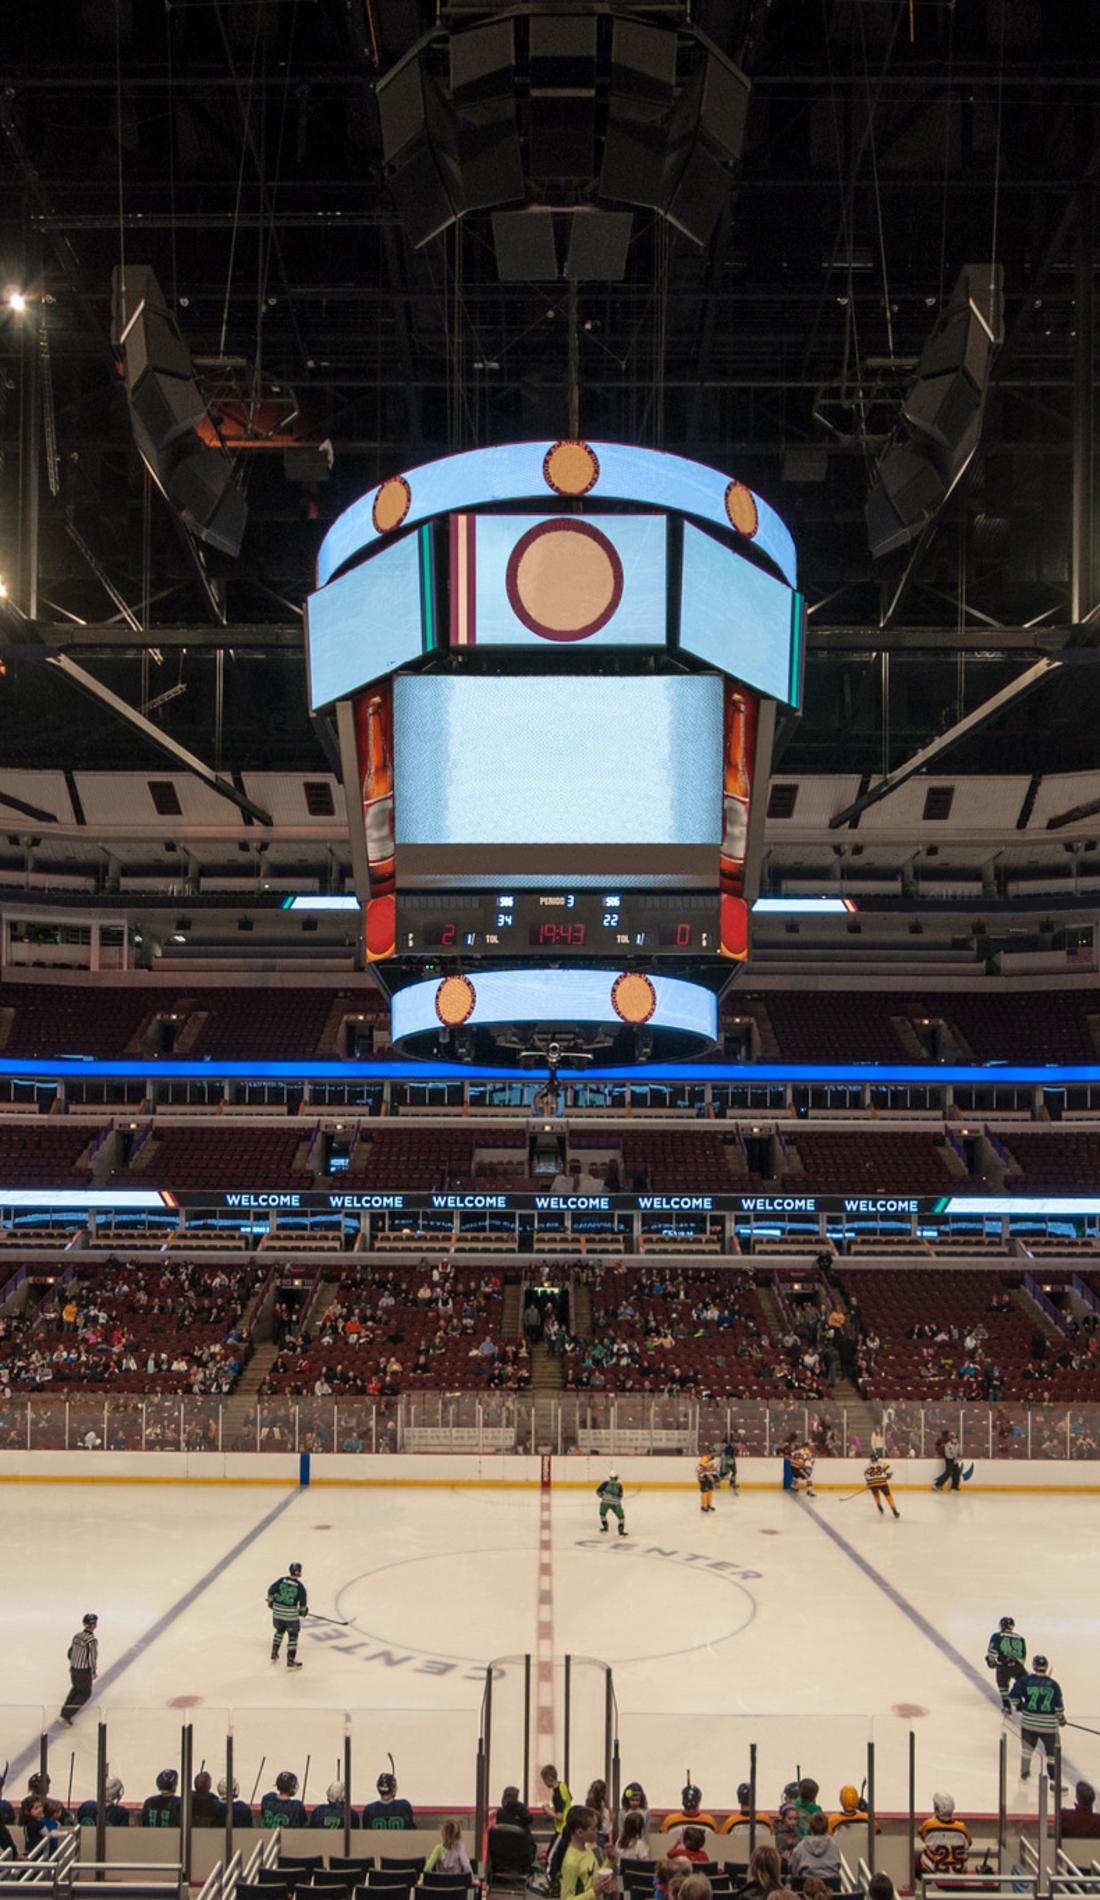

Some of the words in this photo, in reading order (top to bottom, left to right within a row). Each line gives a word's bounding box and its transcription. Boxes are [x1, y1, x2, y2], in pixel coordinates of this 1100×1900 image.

[540, 896, 565, 907] PERIOD
[566, 895, 575, 907] 3
[497, 914, 513, 927] 34
[602, 914, 619, 927] 22
[441, 925, 455, 945] 2
[539, 924, 586, 945] 19:43
[676, 925, 690, 945] 0
[226, 1194, 300, 1207] WELCOME
[329, 1195, 403, 1208] WELCOME
[432, 1195, 506, 1208] WELCOME
[535, 1197, 609, 1210] WELCOME
[638, 1197, 712, 1210] WELCOME
[741, 1198, 815, 1211] WELCOME
[844, 1200, 918, 1213] WELCOME
[574, 1539, 764, 1581] CENTER
[1026, 1686, 1055, 1713] 77
